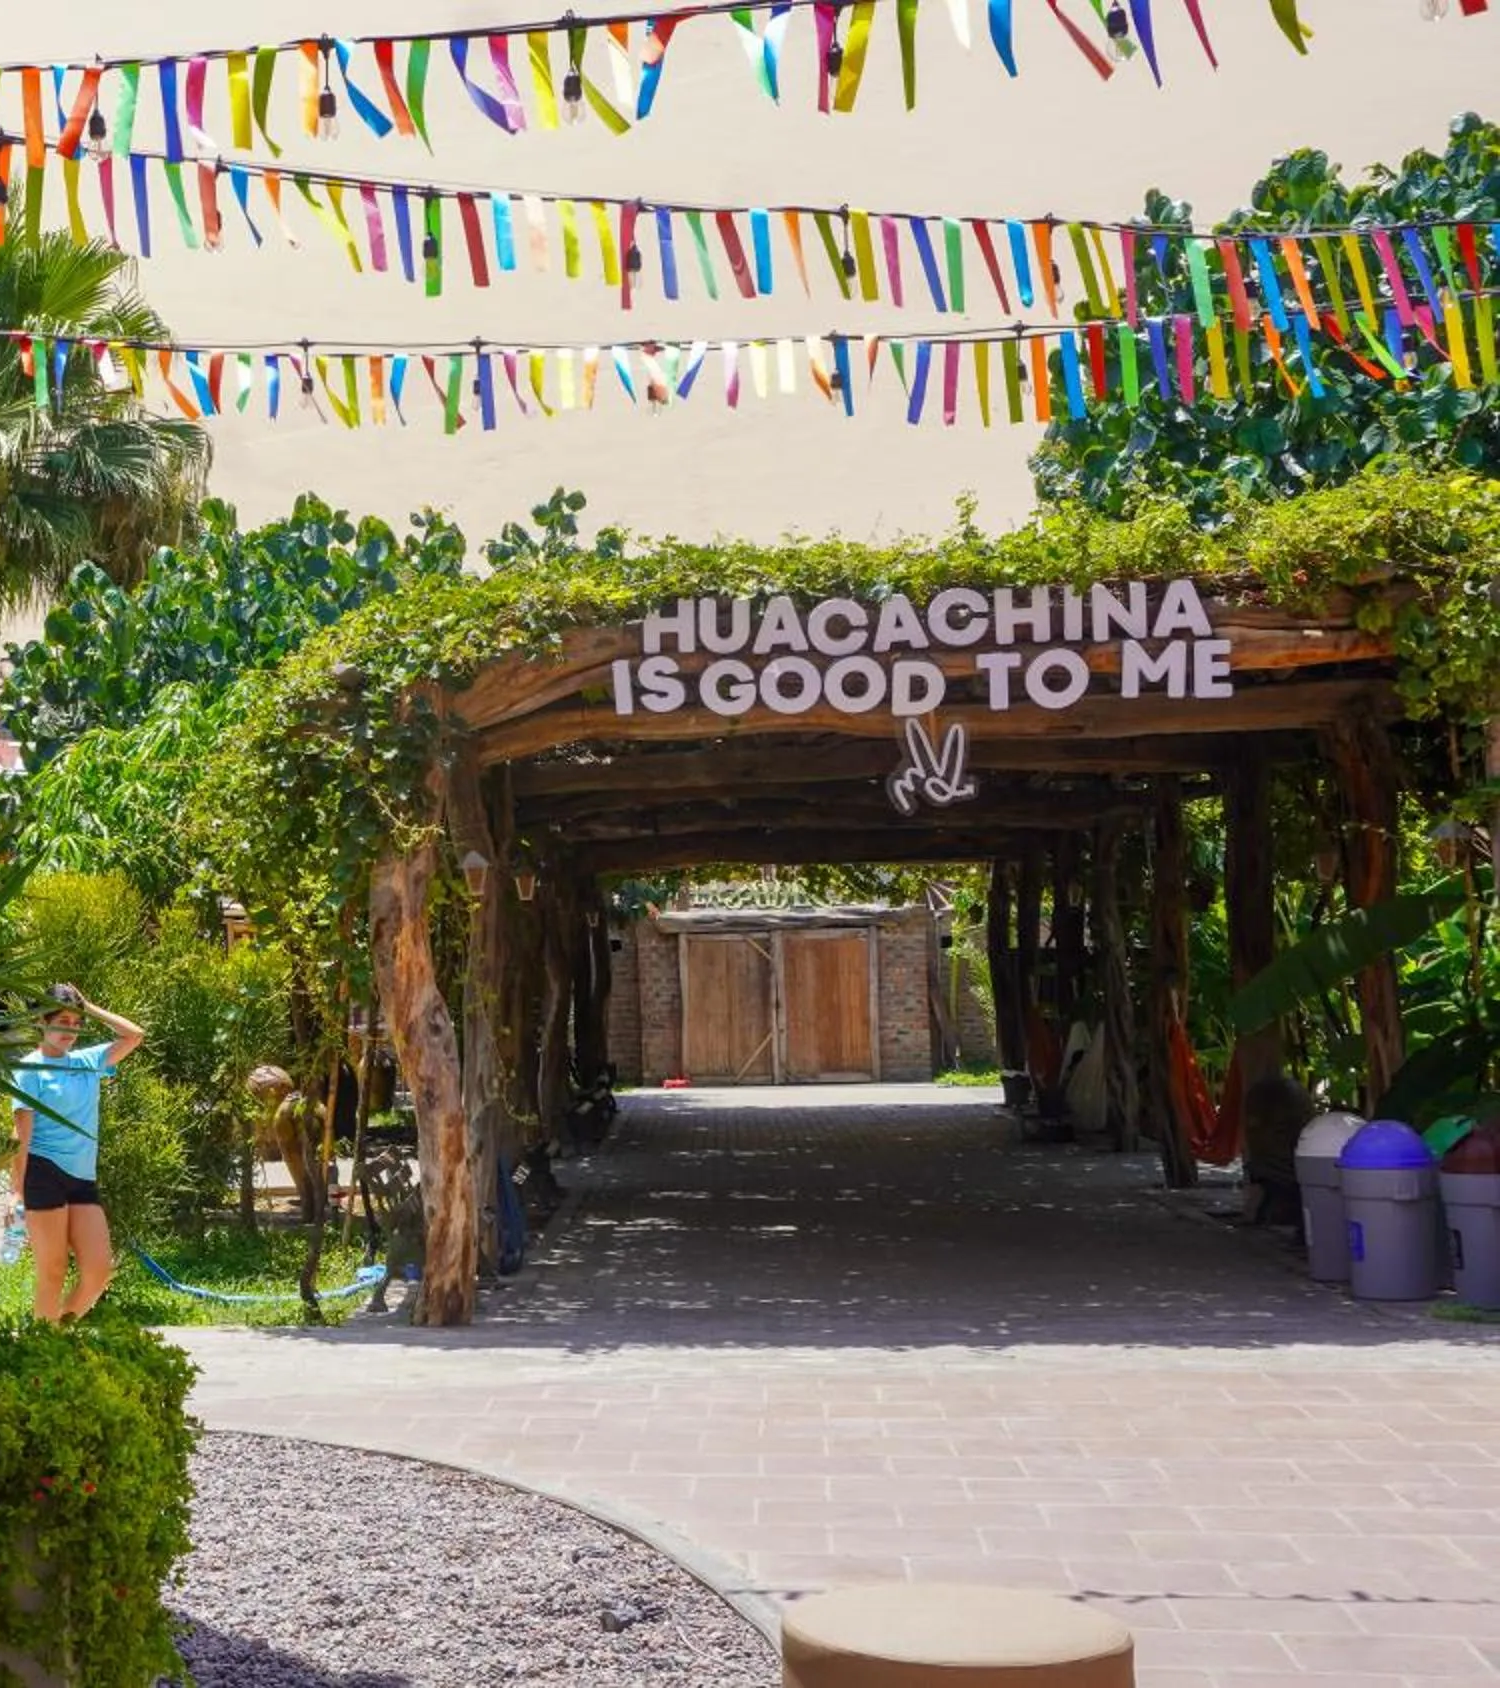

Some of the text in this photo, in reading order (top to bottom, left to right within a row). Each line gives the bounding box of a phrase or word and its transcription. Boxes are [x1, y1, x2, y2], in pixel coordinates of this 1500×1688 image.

[642, 580, 1213, 656] HUACACHINA
[612, 640, 1234, 716] IS GOOD TO ME
